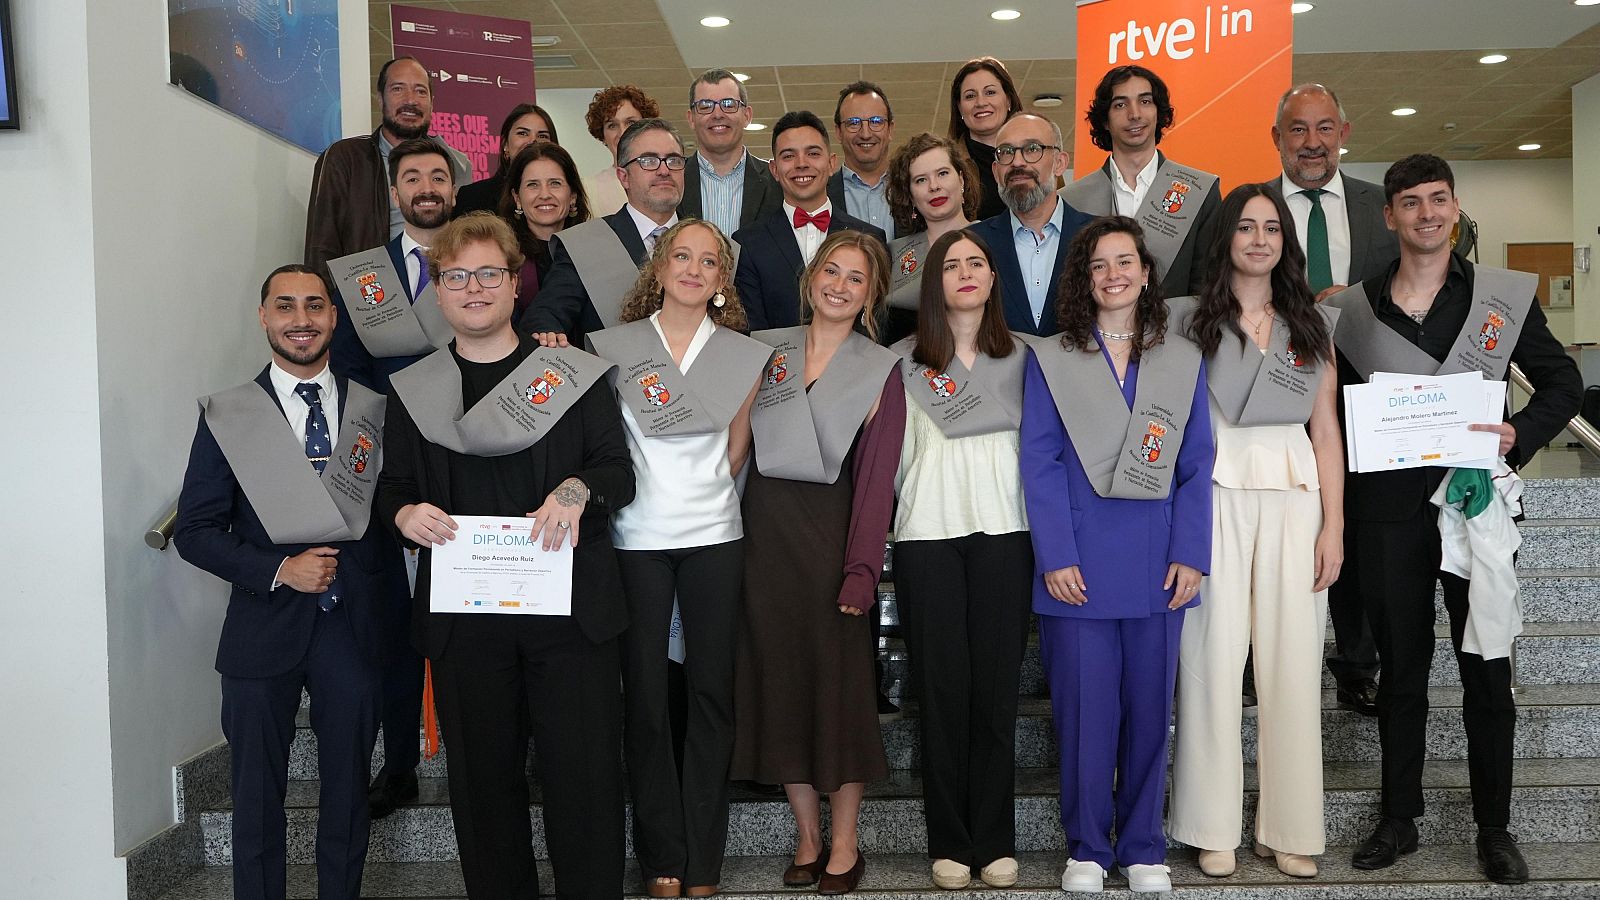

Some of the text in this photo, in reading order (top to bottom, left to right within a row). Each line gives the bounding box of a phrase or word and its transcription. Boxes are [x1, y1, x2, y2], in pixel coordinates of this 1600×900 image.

[1109, 5, 1252, 64] rtve in
[430, 112, 488, 135] REES QUE
[1389, 392, 1447, 407] DIPLOMA
[473, 534, 534, 546] DIPLOMA
